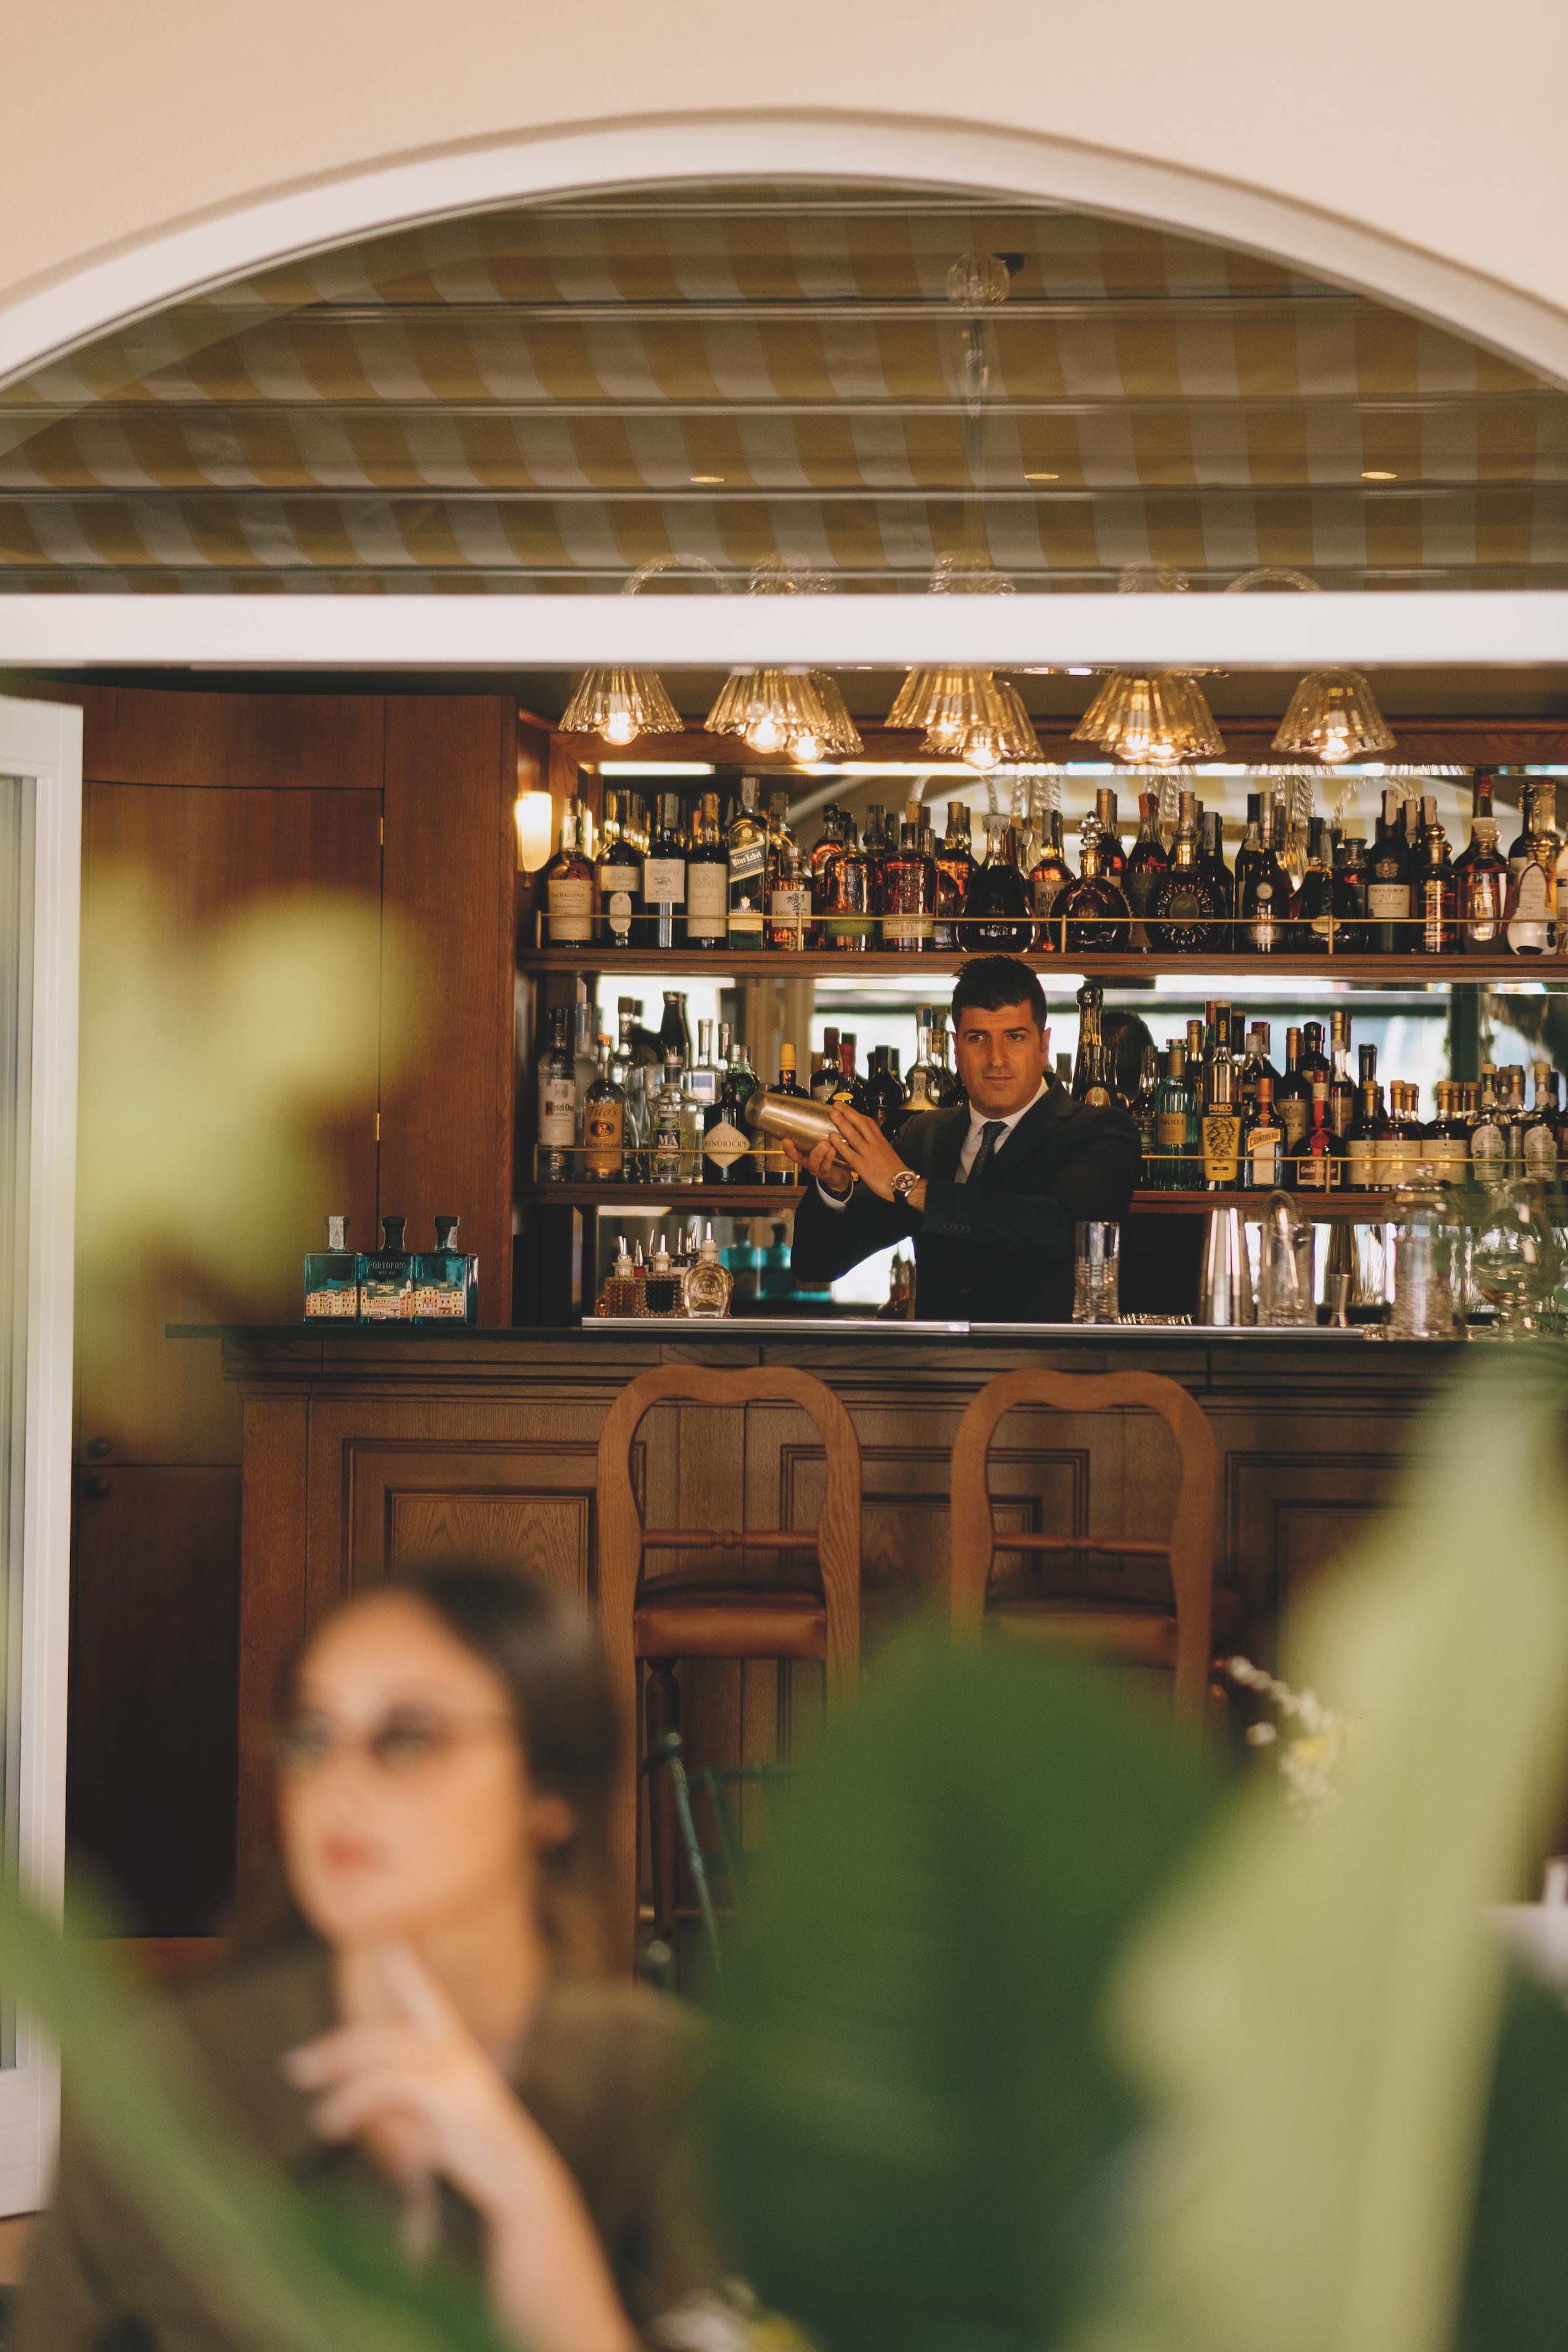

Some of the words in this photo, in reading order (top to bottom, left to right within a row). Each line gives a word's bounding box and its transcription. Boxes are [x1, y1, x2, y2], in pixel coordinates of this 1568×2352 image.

[731, 857, 746, 867] Blue
[745, 851, 762, 862] Label
[1037, 898, 1052, 908] TUR
[588, 1105, 619, 1117] Tito's
[1250, 1132, 1279, 1148] COINTREAU
[368, 1261, 407, 1270] PORTOFINO
